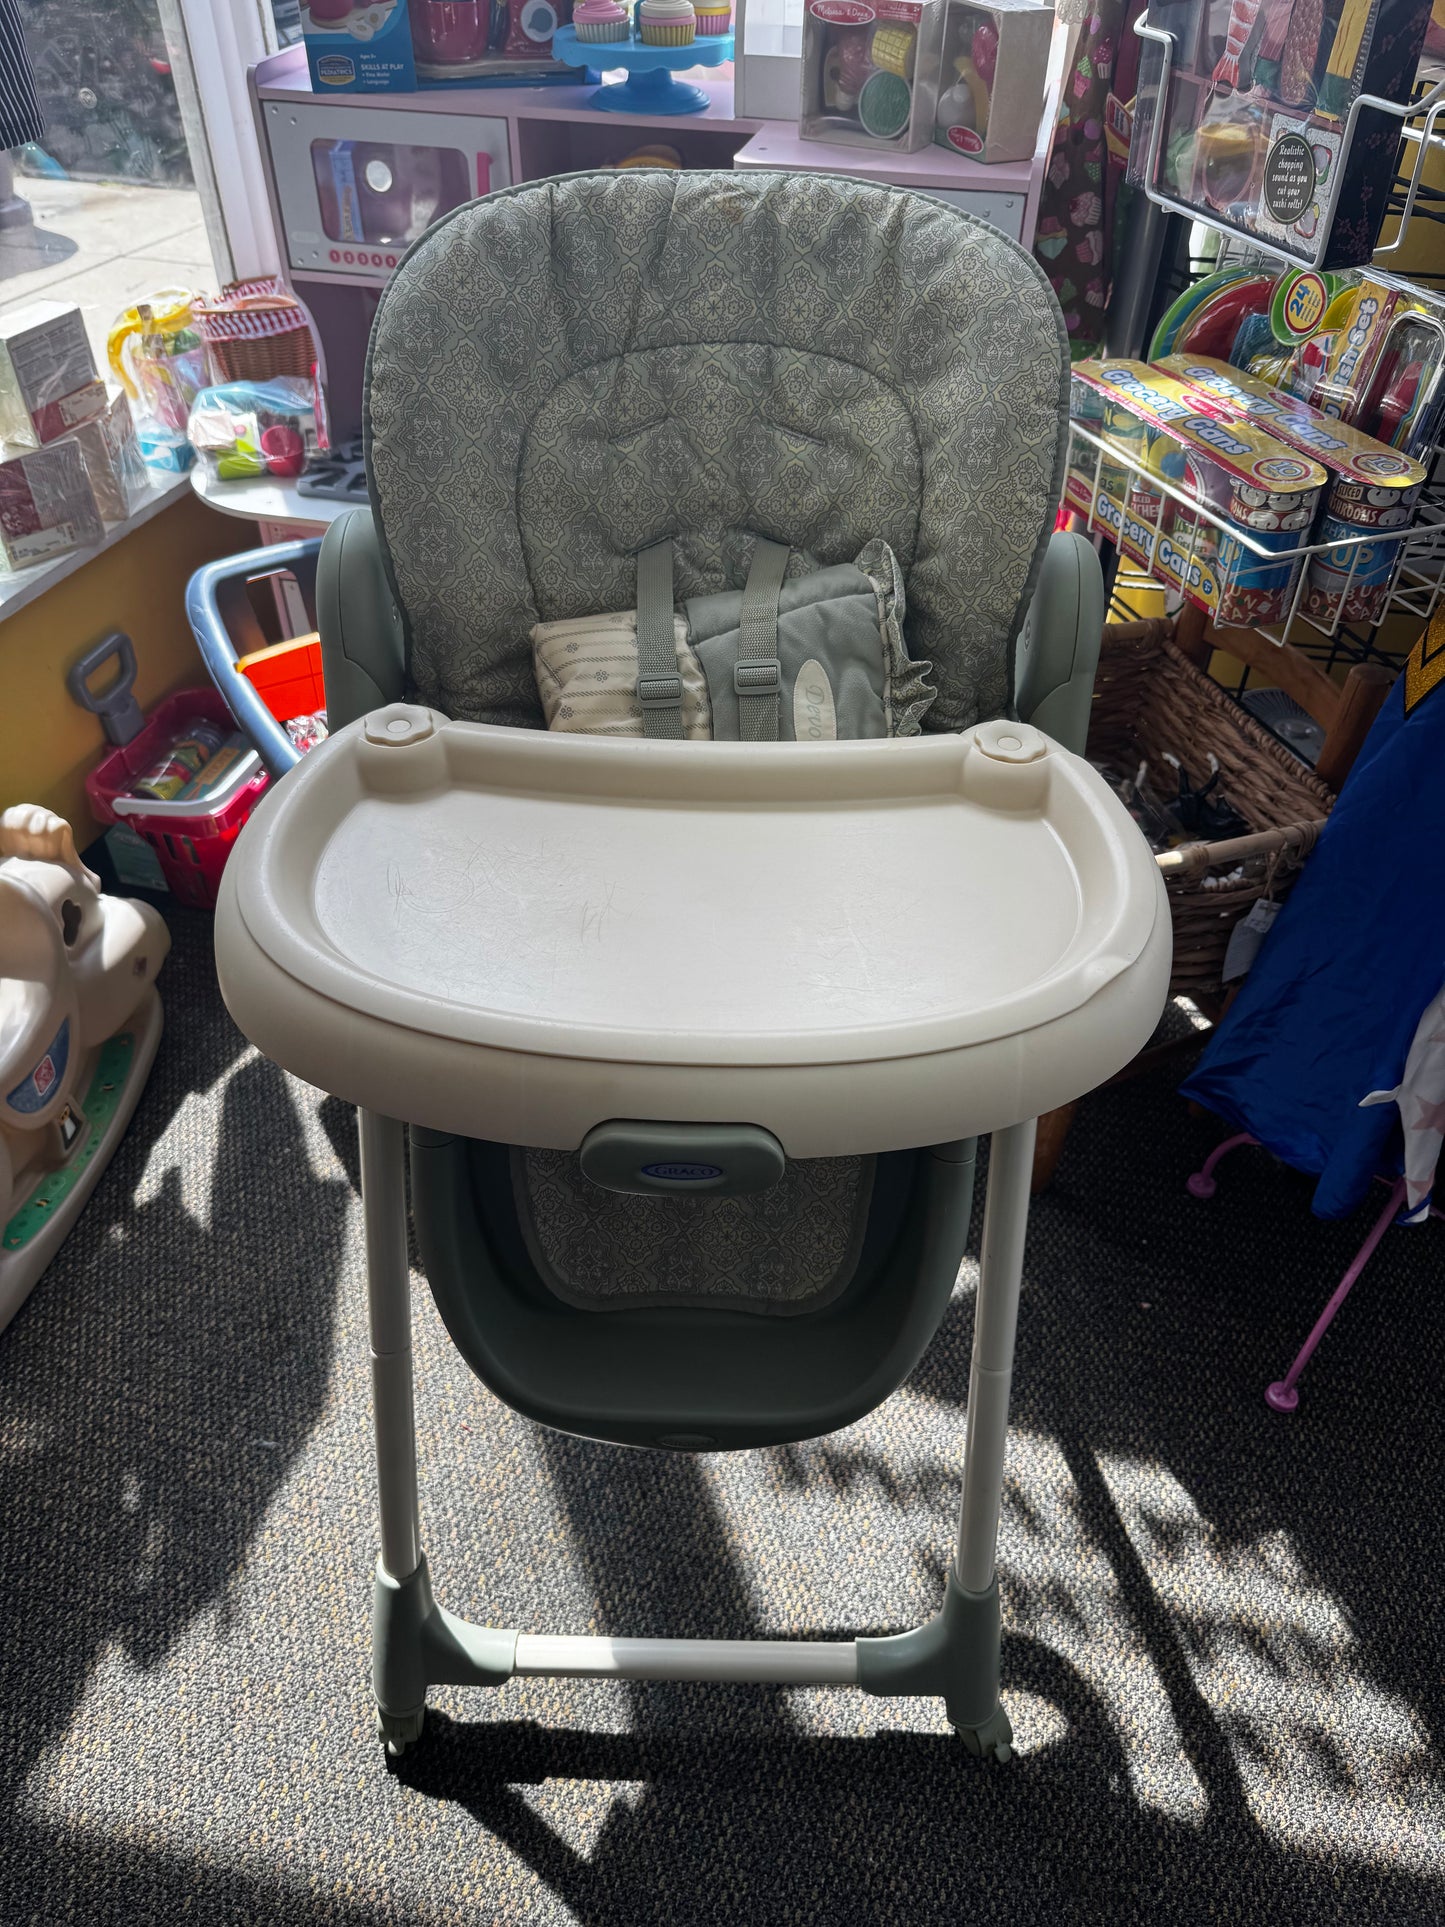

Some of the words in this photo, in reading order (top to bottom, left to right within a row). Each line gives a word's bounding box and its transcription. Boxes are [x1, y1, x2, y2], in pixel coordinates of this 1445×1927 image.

[1279, 144, 1305, 156] Realistic
[1278, 159, 1304, 171] chopping
[1272, 172, 1289, 182] sound
[1297, 175, 1308, 185] you
[1277, 185, 1287, 195] cut
[1287, 189, 1300, 197] your
[1273, 199, 1287, 208] sushi
[1289, 284, 1312, 317] 24
[1347, 297, 1379, 346] Set
[1101, 369, 1192, 420] Grocery
[1183, 417, 1253, 455] Cans
[1184, 367, 1281, 415] Grocery
[1274, 414, 1348, 450] Cans
[1268, 461, 1302, 477] 10
[1367, 456, 1401, 472] 10
[1101, 478, 1114, 490] as
[1337, 485, 1361, 498] SLICED
[1330, 500, 1377, 523] SHROOMS
[1096, 494, 1155, 558] Grocery
[806, 685, 824, 738] Devo
[655, 1166, 714, 1176] GRACO
